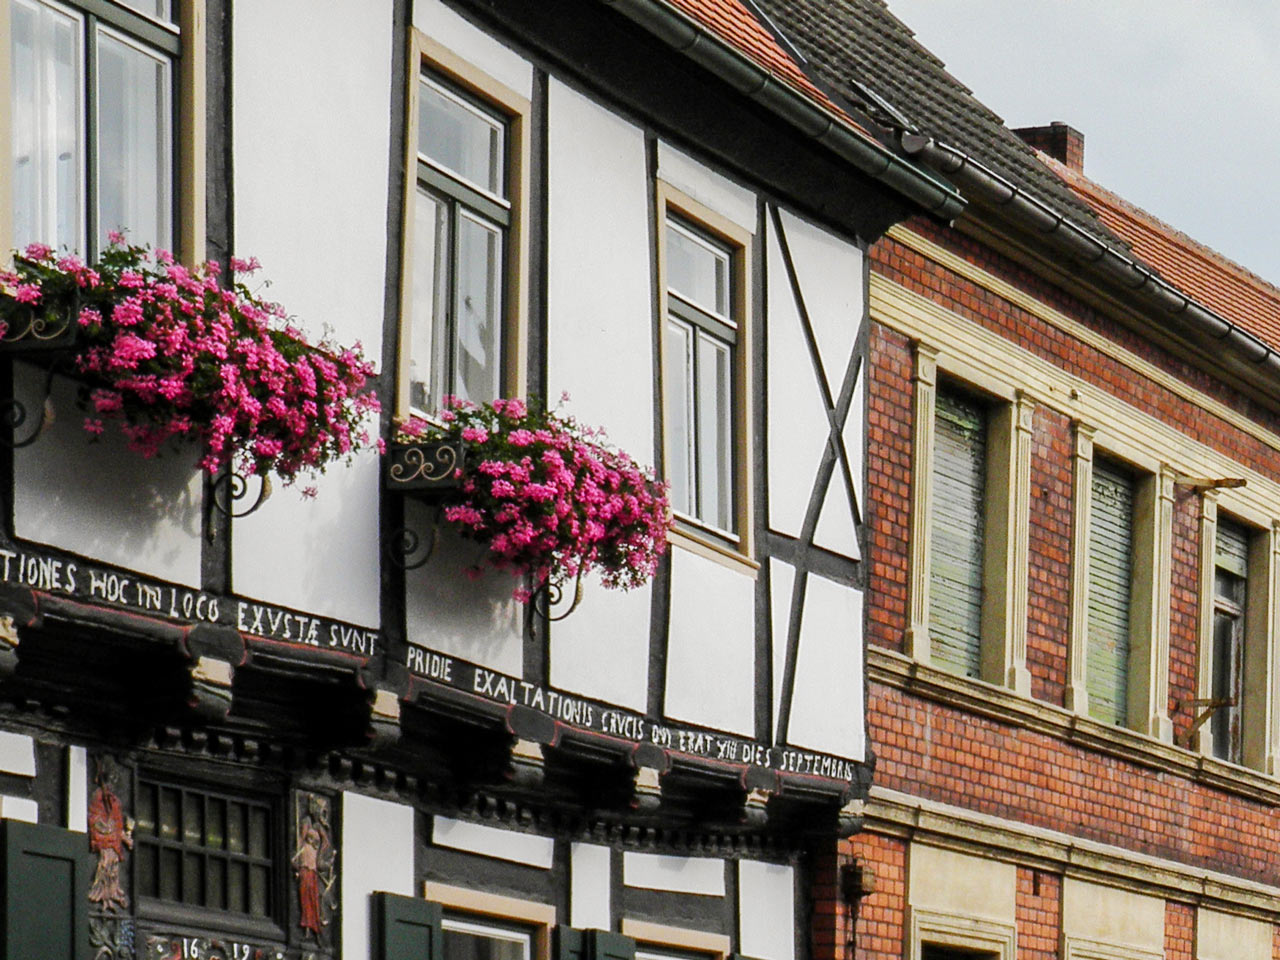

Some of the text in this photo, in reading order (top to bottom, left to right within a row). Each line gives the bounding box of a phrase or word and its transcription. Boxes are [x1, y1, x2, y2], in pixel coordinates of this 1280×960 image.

[89, 570, 129, 604] HOC
[136, 582, 162, 610] IN
[170, 588, 219, 623] LOCO
[329, 623, 379, 656] SVNT
[406, 646, 453, 682] PRIDIE
[473, 668, 594, 728] EXALTATIONIS
[601, 711, 645, 741] CRVCIS
[678, 730, 714, 754] ERAT
[742, 743, 772, 769] DIES
[780, 751, 855, 782] SEPTEMBRIS
[183, 938, 199, 959] 16
